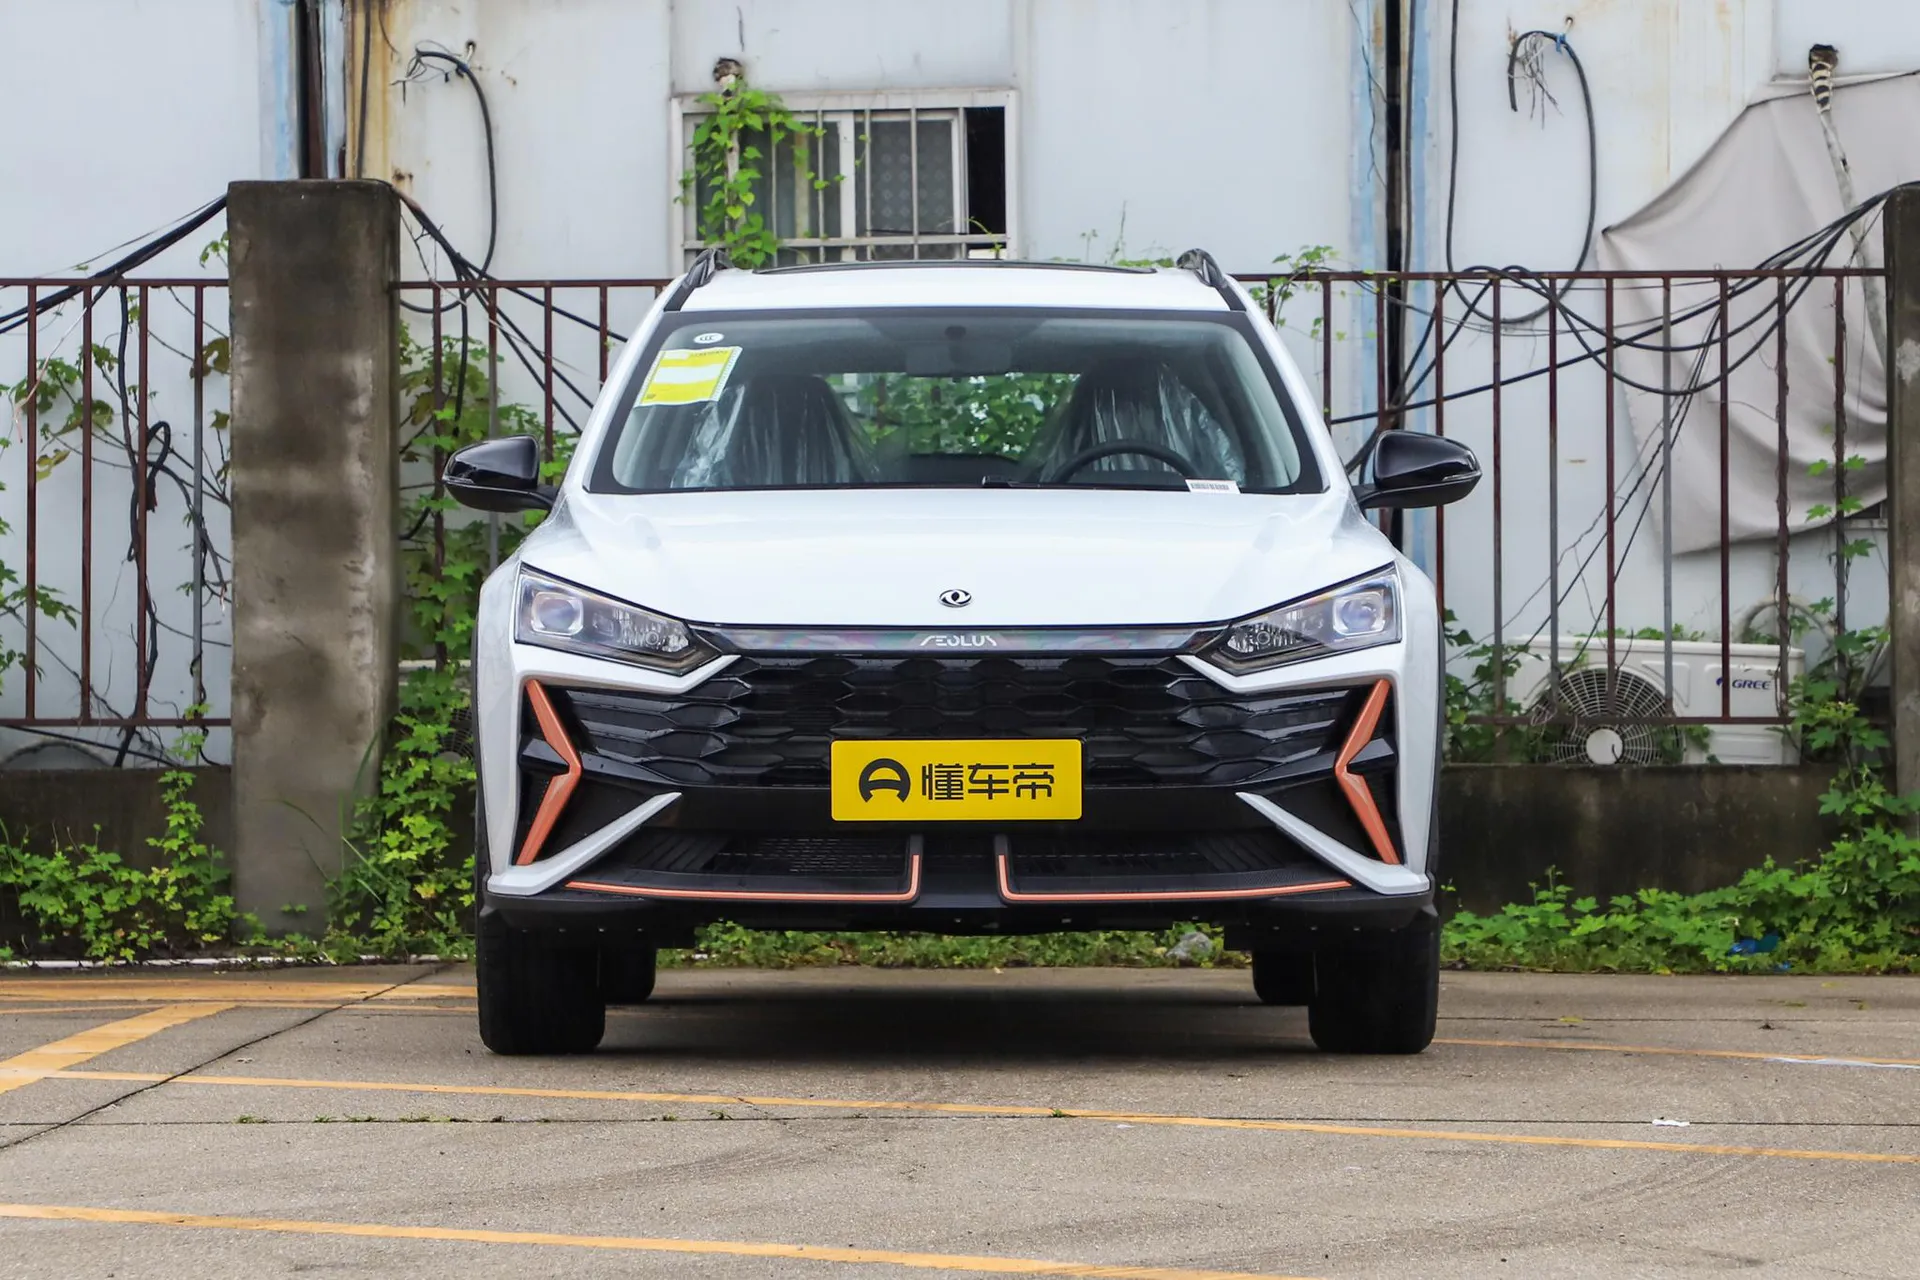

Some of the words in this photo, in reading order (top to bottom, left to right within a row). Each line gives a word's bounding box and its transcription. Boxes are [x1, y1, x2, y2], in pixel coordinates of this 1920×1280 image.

[1731, 679, 1772, 691] GREE
[921, 762, 1055, 801] 懂车帝
